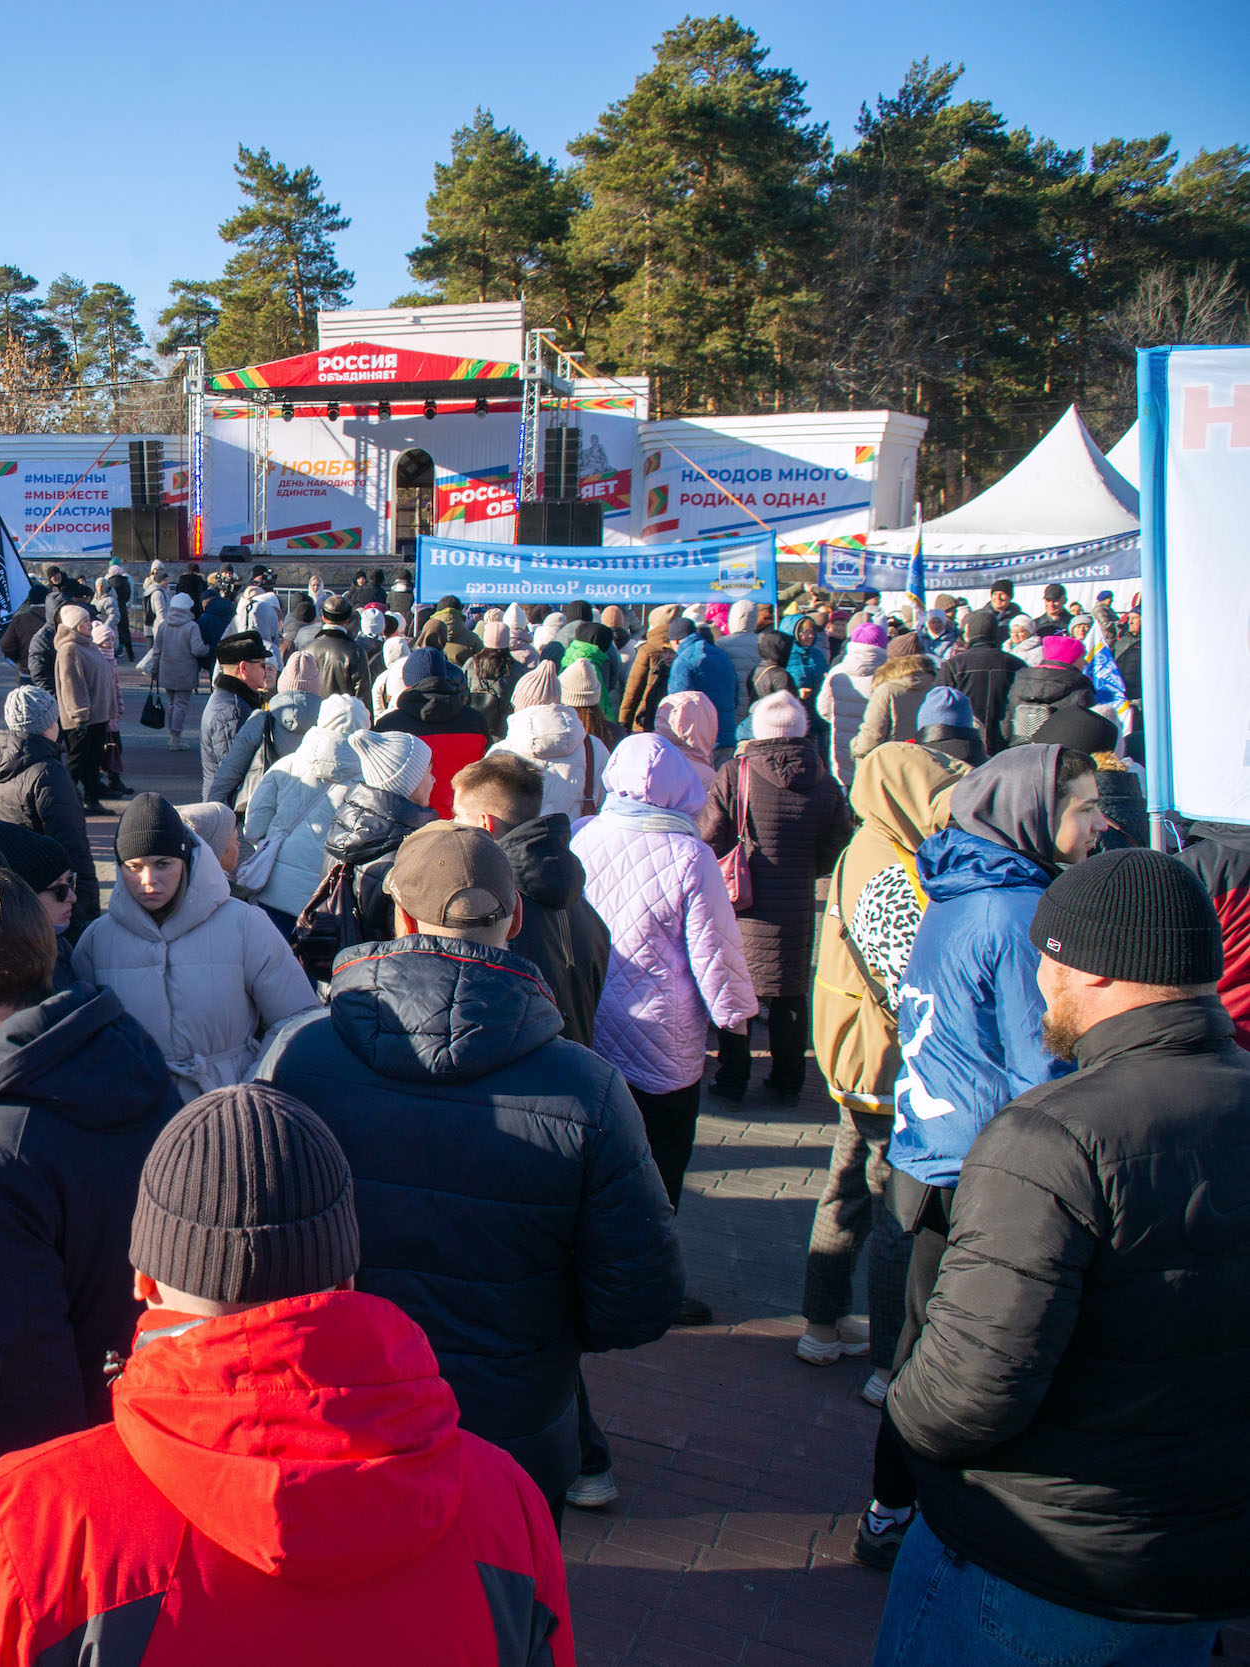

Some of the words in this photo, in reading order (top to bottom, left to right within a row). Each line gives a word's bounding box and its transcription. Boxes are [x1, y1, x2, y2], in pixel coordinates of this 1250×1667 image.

[318, 354, 397, 371] РОССИЯ
[318, 370, 397, 382] ОБЪЕДИНЯЕТ
[281, 460, 371, 476] НОЯБРЯ
[24, 474, 106, 485] #МЫЕДИНЫ
[682, 469, 773, 484] НАРОДОВ
[778, 468, 848, 481] МНОГО
[278, 480, 304, 488] ДЕНЬ
[306, 480, 366, 488] НАРОДНОГО
[24, 490, 109, 500] #МЫВМЕСТЕ
[276, 489, 327, 497] ЕДИНСТВА
[450, 482, 518, 506] РОССИ
[680, 492, 756, 508] РОДИНА
[763, 492, 826, 508] ОДНА!
[24, 507, 112, 517] #ОДНАСТРАН
[24, 523, 110, 533] #МЫРОССИЯ
